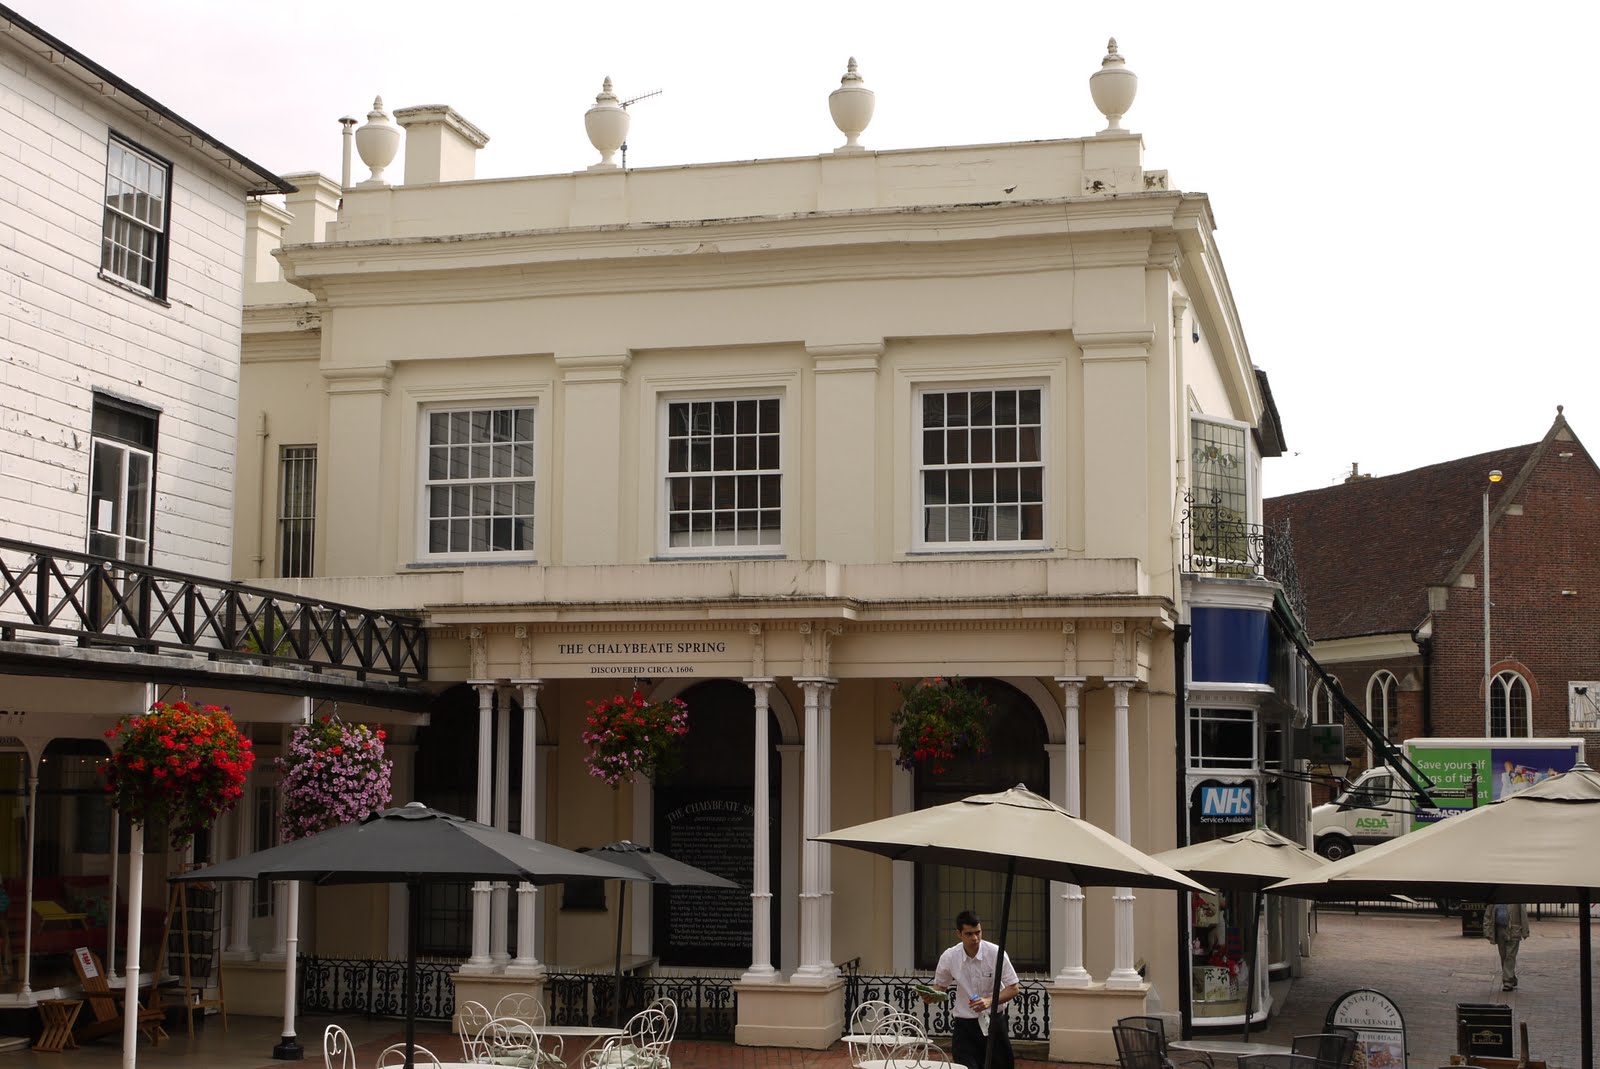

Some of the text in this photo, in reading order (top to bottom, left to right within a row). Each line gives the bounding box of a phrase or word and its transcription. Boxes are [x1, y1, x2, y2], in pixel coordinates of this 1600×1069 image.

[558, 642, 726, 654] THE CHALYBEATE SPRING
[590, 665, 694, 674] DISCOVERED CIRCA 1606
[1417, 760, 1441, 769] Save
[1417, 773, 1442, 785] bgs
[1445, 773, 1456, 782] of
[1203, 788, 1251, 814] NHS
[666, 800, 755, 823] THE CHALYBEATE SP
[1355, 818, 1389, 828] ASDA
[1340, 995, 1395, 1018] RESTAURANT
[1340, 1018, 1397, 1026] DELICATESSEN
